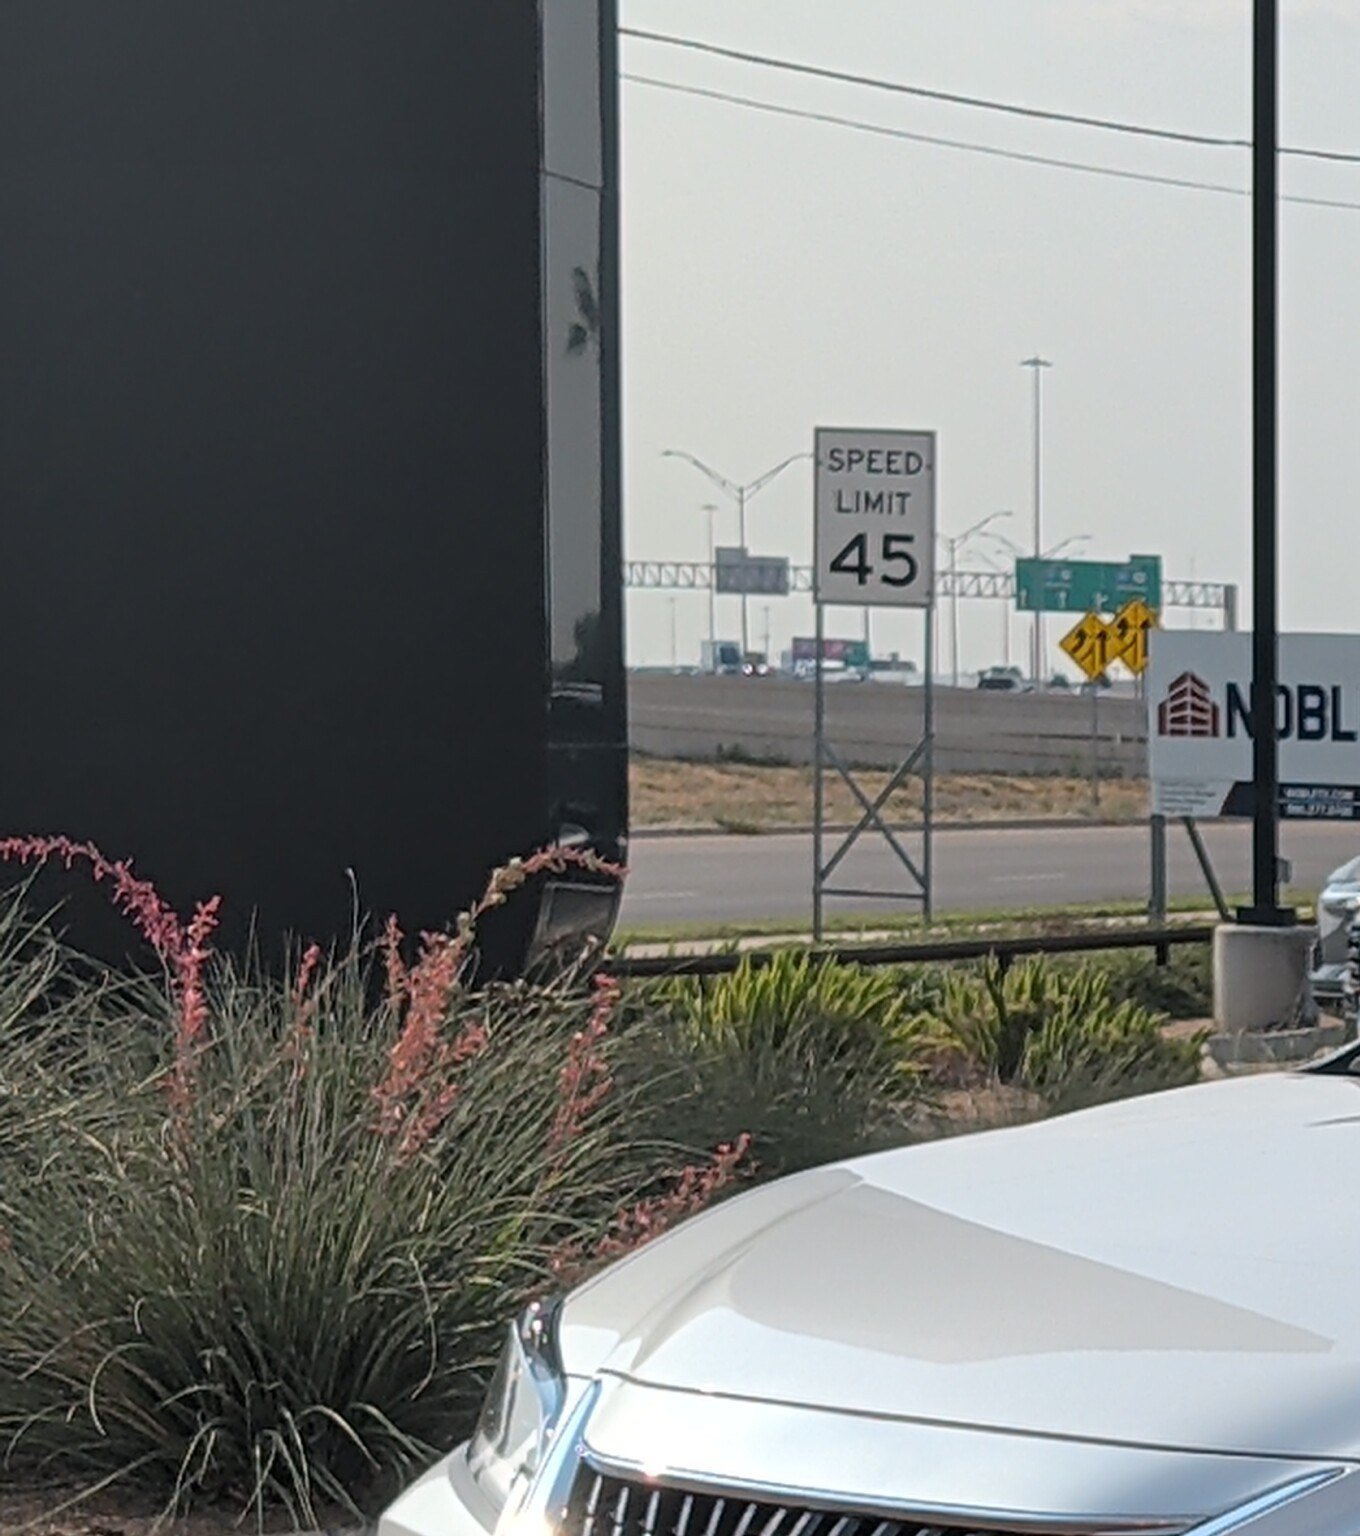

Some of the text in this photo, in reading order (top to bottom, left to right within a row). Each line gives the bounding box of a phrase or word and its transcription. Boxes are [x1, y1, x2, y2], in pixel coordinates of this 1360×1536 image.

[828, 448, 923, 475] SPEED
[836, 490, 911, 516] LIMIT
[829, 532, 918, 588] 45
